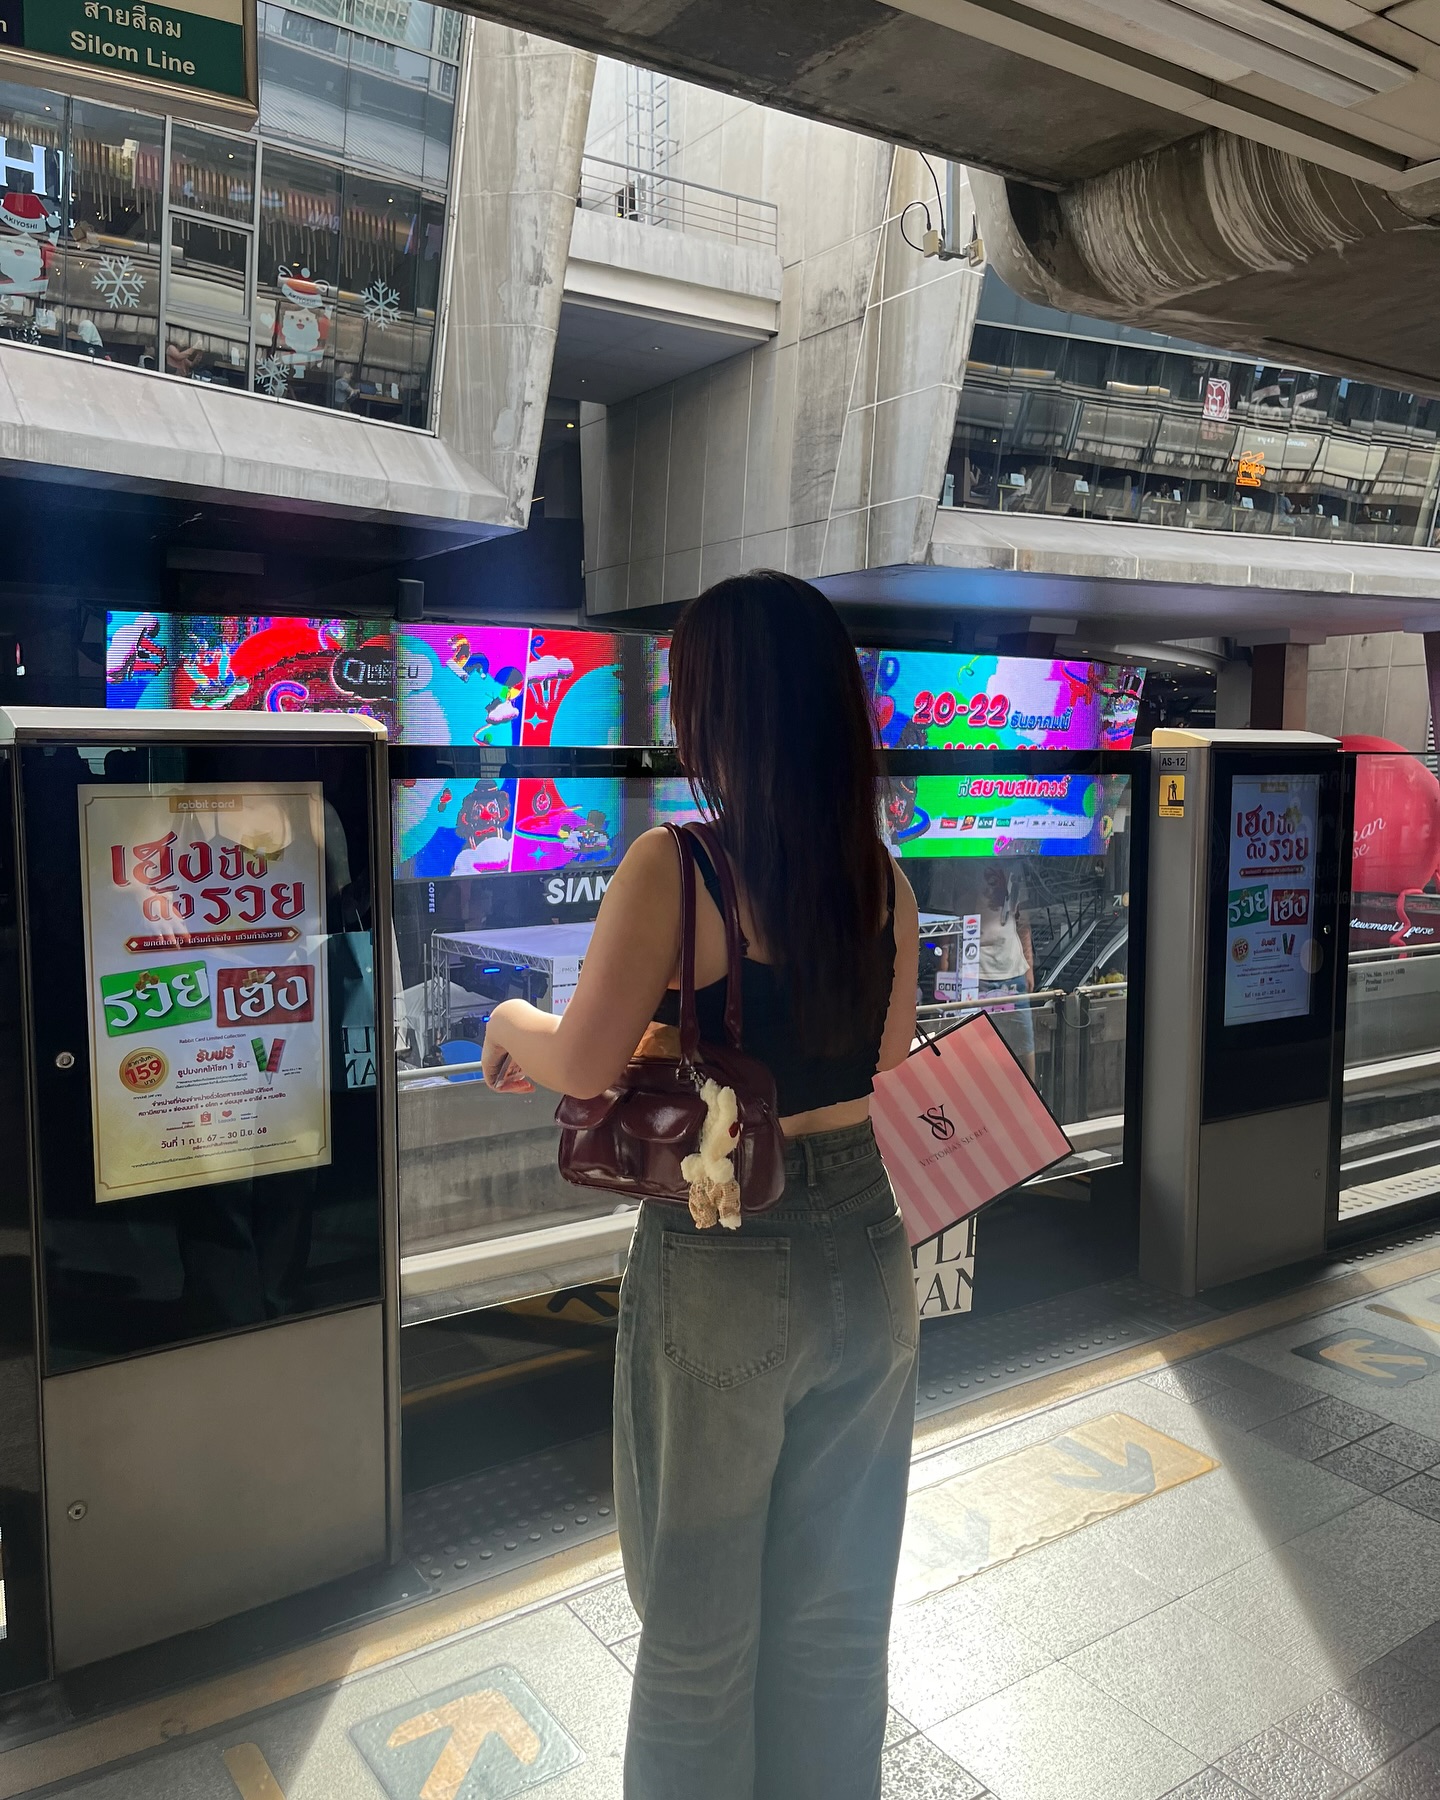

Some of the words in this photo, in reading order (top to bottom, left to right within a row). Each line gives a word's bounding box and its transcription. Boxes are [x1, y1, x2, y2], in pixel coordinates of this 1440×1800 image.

[84, 1, 181, 39] สายสีลม
[70, 31, 138, 63] Silom
[146, 47, 196, 76] Line
[3, 214, 38, 230] AKIYOSHI
[912, 690, 1010, 729] 20-22
[1161, 757, 1186, 767] AS-12
[177, 800, 209, 810] rabbit
[211, 800, 235, 809] card
[428, 881, 436, 914] COFFEE
[104, 968, 210, 1027] รวย
[223, 971, 308, 1021] เฮง
[125, 1059, 162, 1085] 159
[161, 1136, 178, 1149] วันที่
[207, 1134, 218, 1142] 67
[227, 1131, 238, 1139] 30
[257, 1126, 268, 1135] 68
